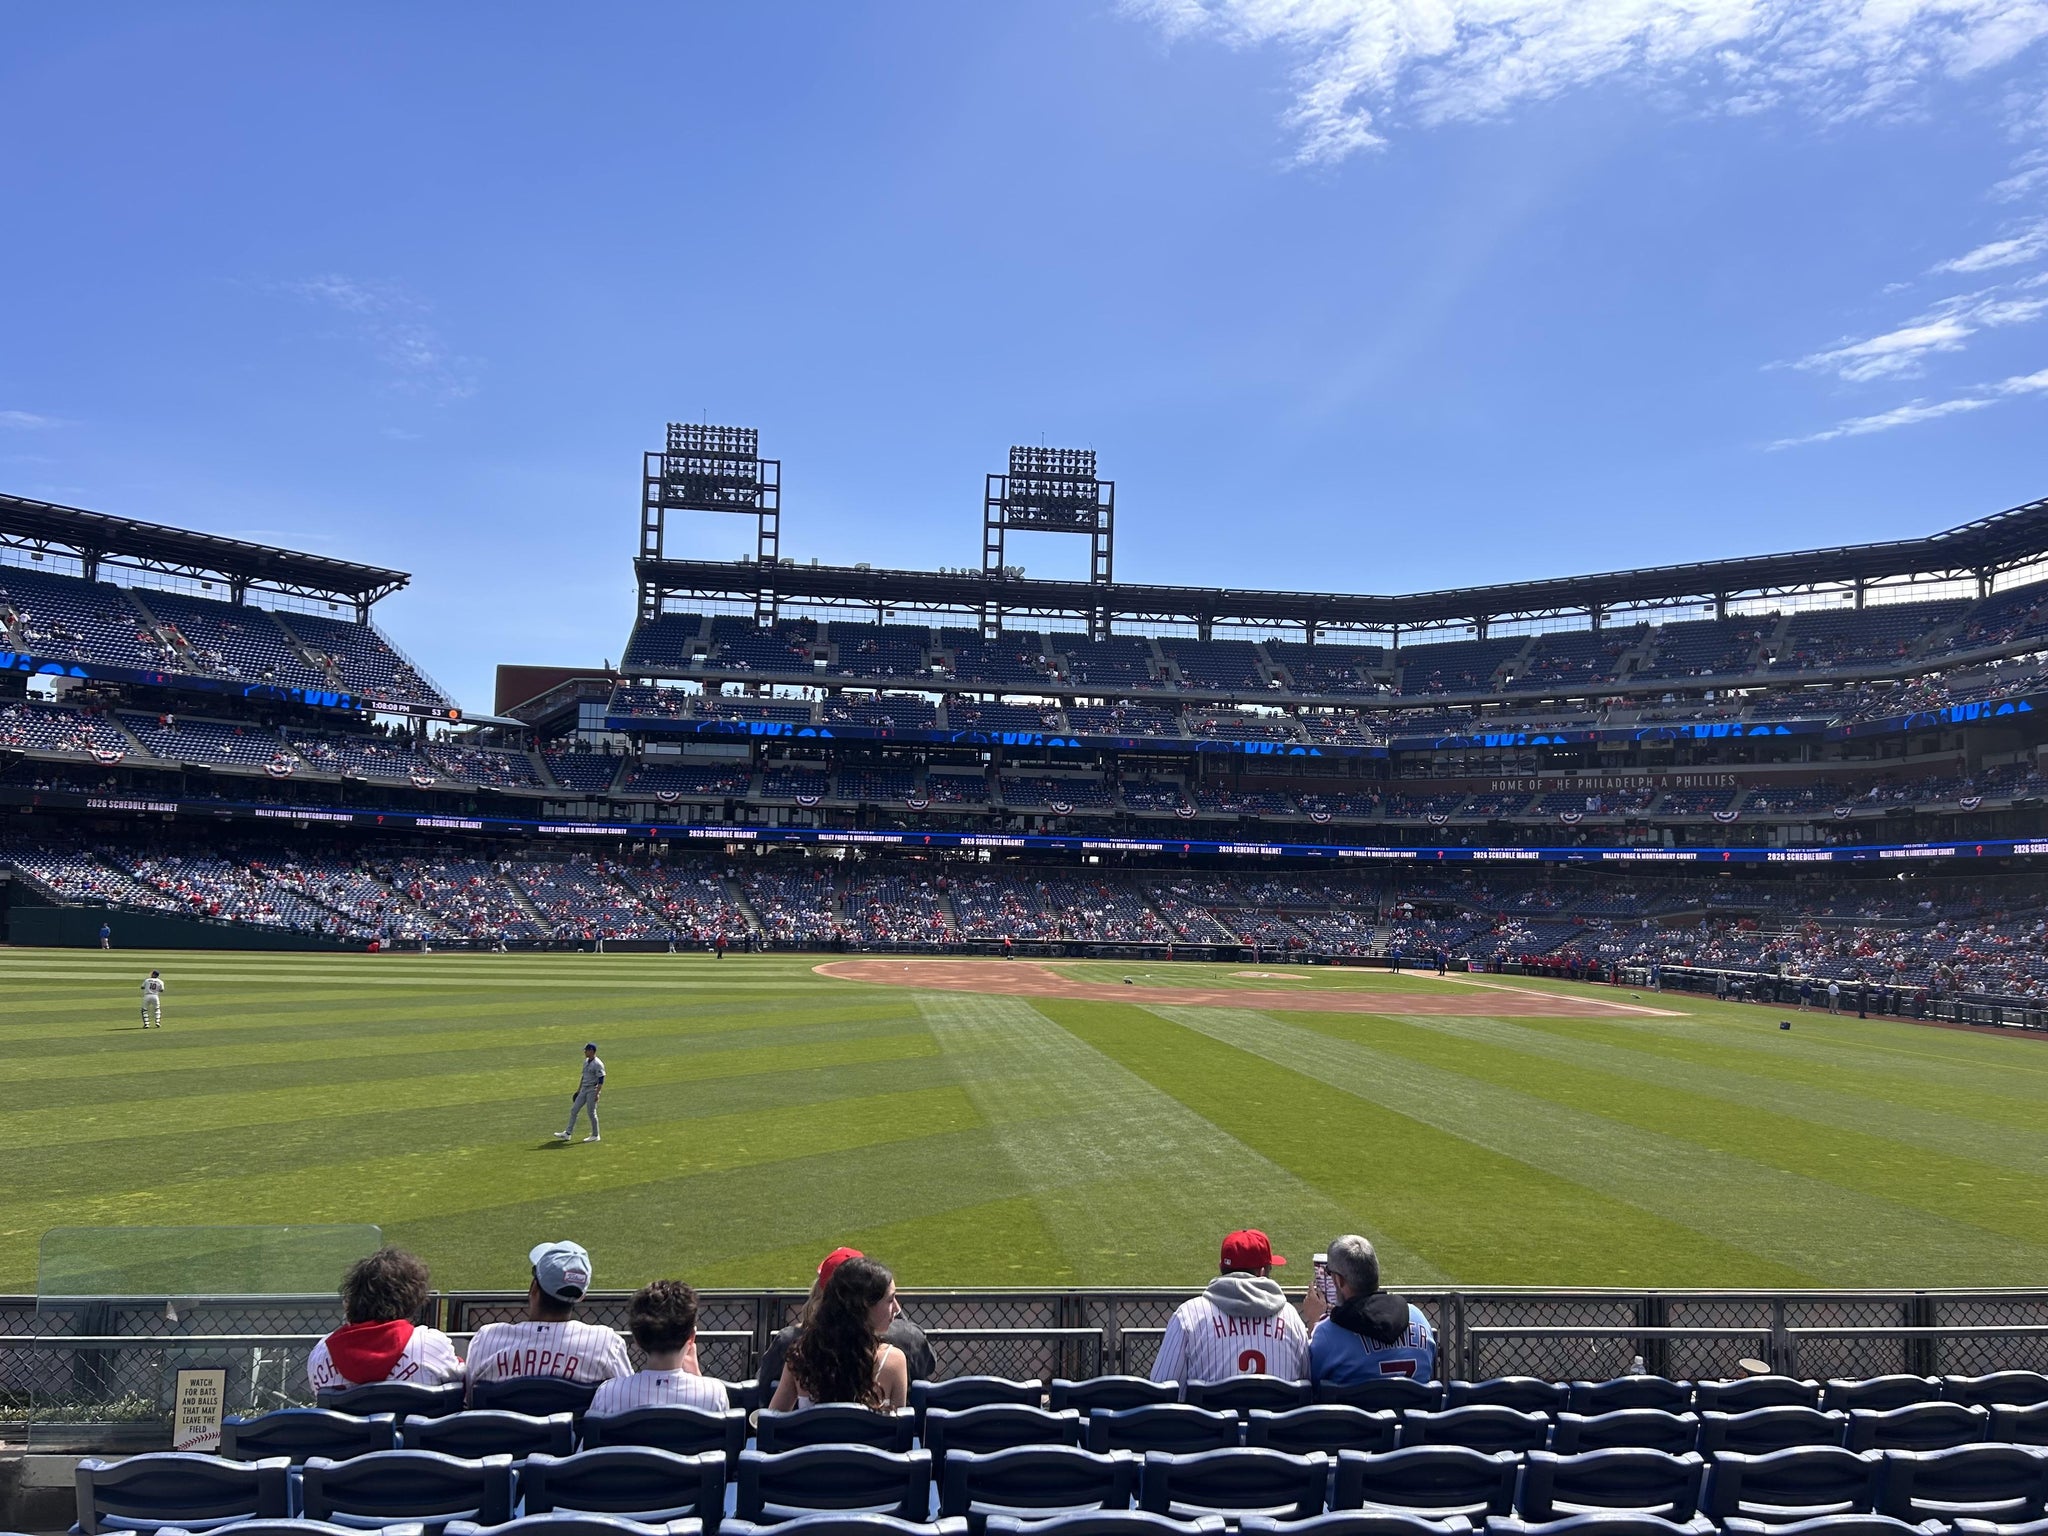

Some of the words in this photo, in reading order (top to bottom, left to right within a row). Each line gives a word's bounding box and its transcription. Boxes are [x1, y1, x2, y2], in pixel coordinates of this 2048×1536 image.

[372, 702, 398, 710] 1:08:08
[1491, 781, 1522, 790] HOME
[1529, 780, 1542, 789] OF
[1578, 777, 1667, 788] PHILADELPHA
[1676, 775, 1735, 787] PHILLIES
[87, 799, 107, 808] 2026
[109, 800, 146, 810] SCHEDULE
[148, 802, 178, 811] MAGNET
[432, 819, 459, 828] SCHEDULE
[2014, 845, 2029, 853] 2026
[1213, 1315, 1285, 1341] HARPER
[497, 1349, 578, 1380] HARPER
